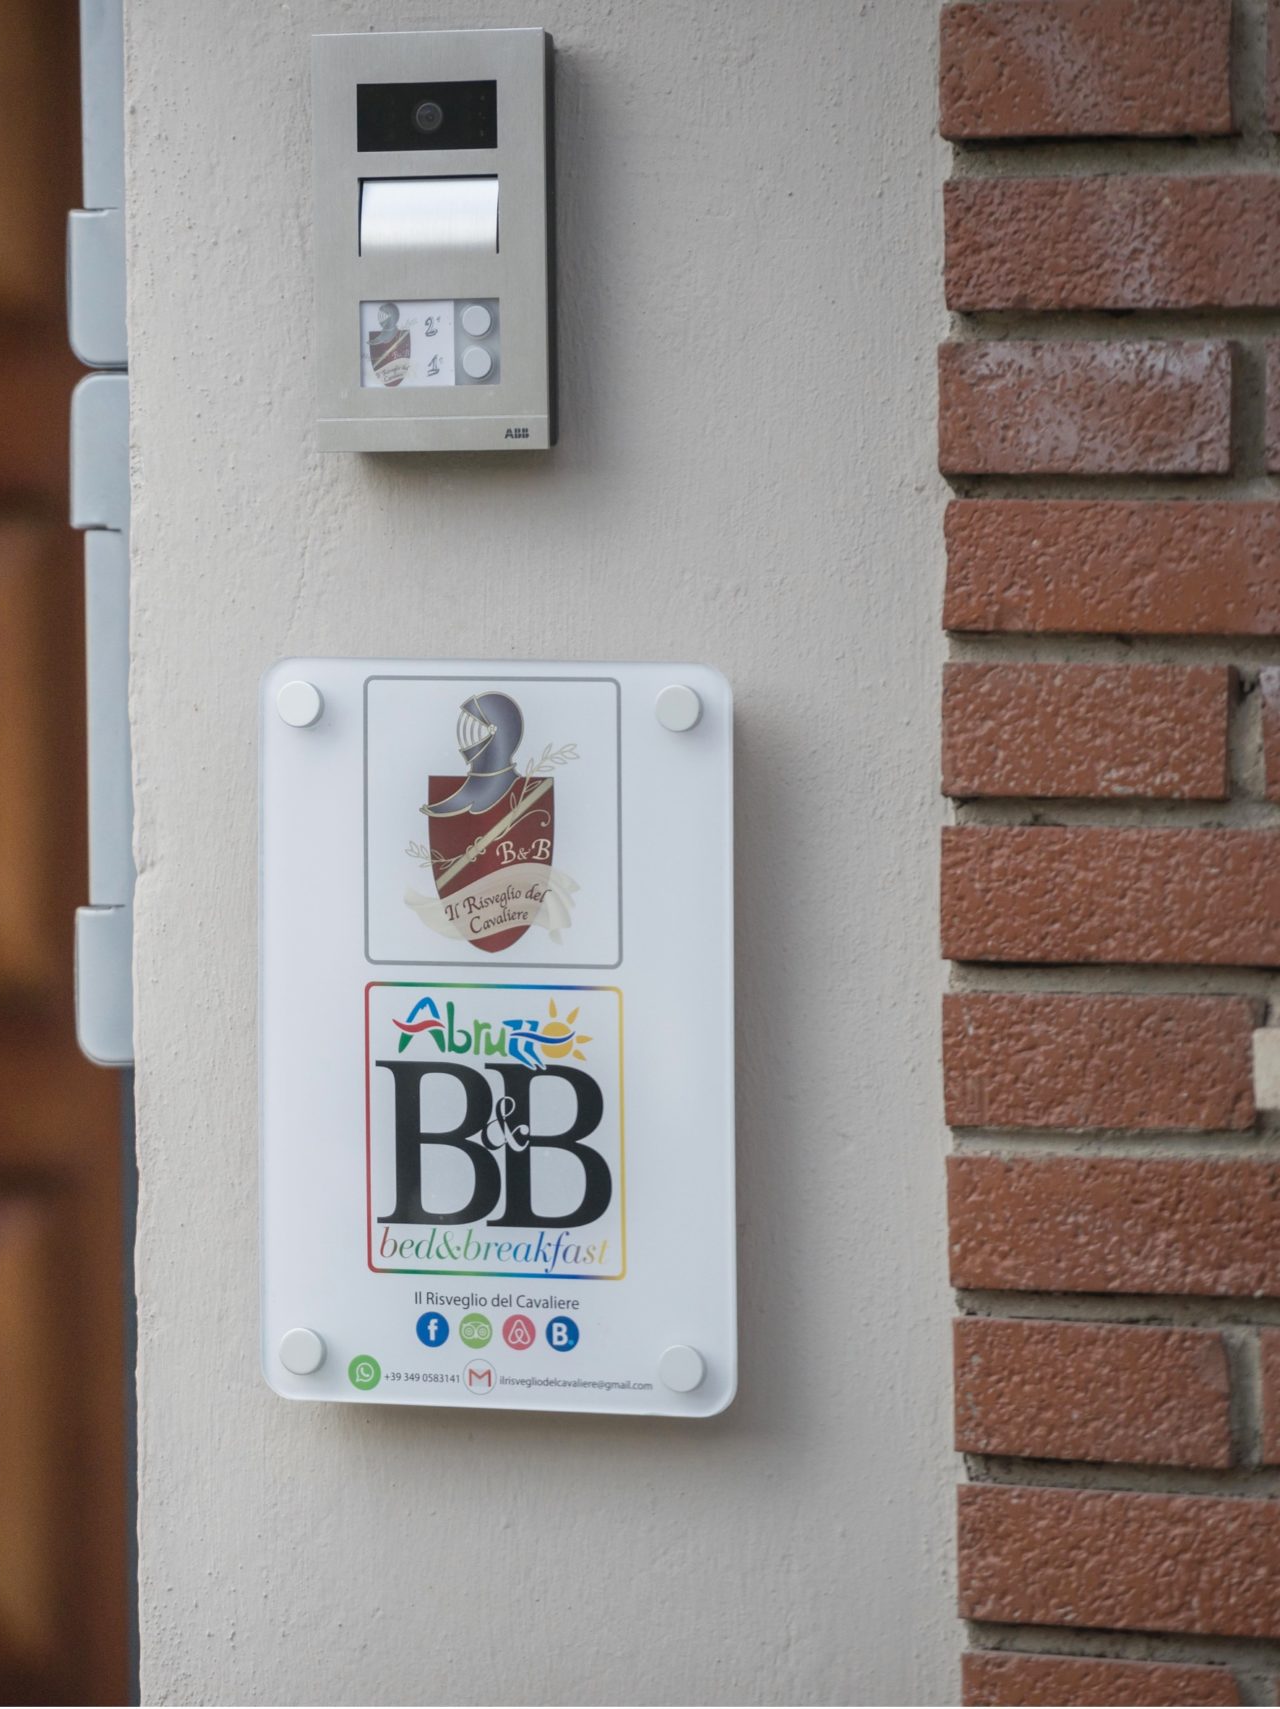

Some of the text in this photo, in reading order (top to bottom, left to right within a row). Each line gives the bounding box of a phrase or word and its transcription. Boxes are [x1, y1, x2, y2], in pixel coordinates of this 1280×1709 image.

[504, 428, 529, 439] ABB
[496, 838, 551, 865] B&B
[444, 884, 553, 921] Il Risveglio del
[469, 907, 529, 934] Cavaliere
[375, 1060, 613, 1229] B&B
[379, 1226, 608, 1273] bed&breakfast
[415, 1291, 580, 1310] Il Risveglio del Cavaliere
[384, 1372, 402, 1382] +39
[404, 1373, 421, 1383] 349
